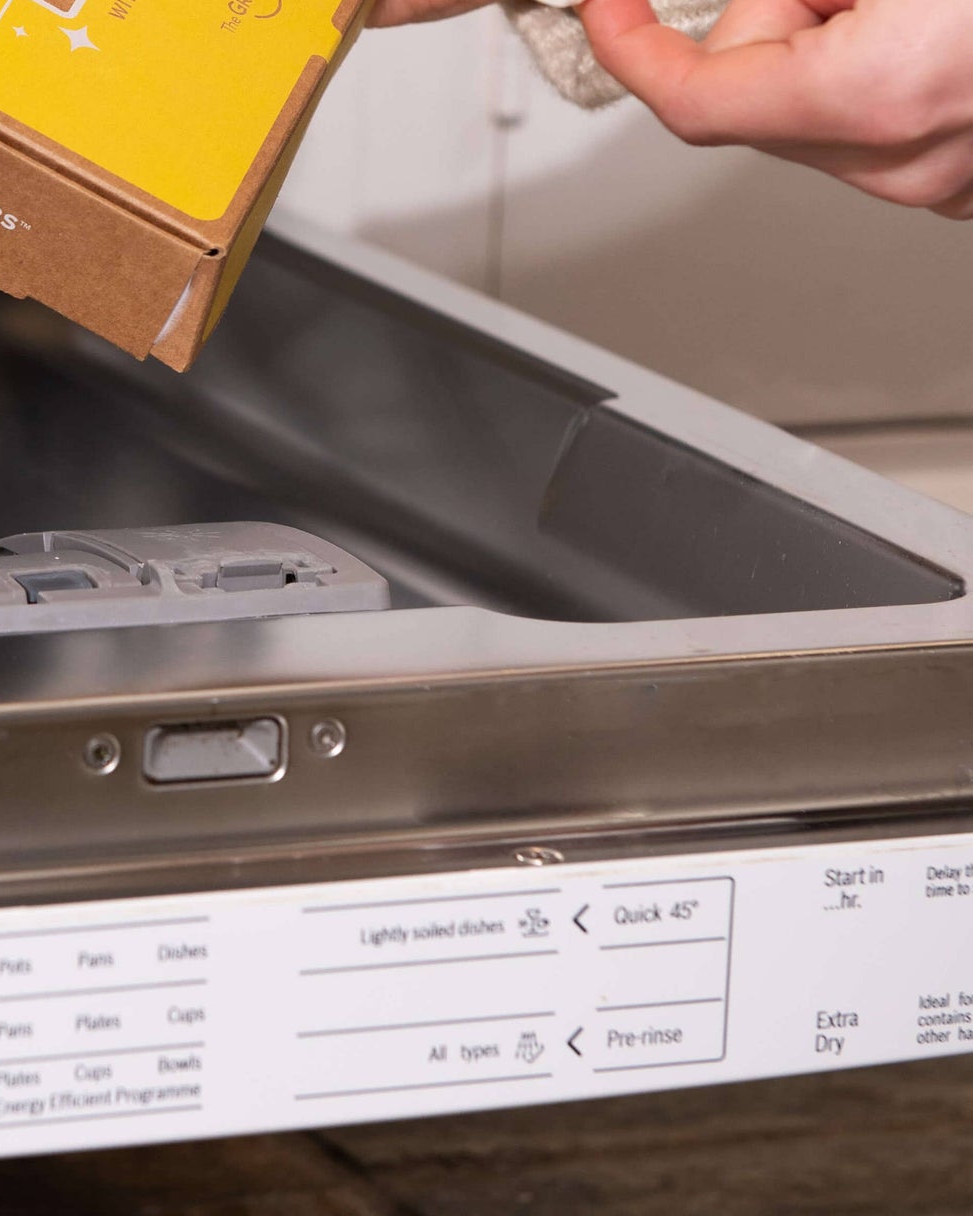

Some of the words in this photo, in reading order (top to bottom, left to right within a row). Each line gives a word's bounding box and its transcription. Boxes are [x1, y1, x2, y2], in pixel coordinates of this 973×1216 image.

[220, 16, 241, 33] The
[824, 867, 866, 887] Start
[868, 865, 884, 884] in
[927, 865, 961, 881] Delay
[926, 884, 954, 897] time
[957, 883, 970, 895] to
[614, 903, 662, 926] Quick
[669, 899, 699, 920] 45°
[361, 925, 408, 945] Lightly
[412, 919, 455, 940] soiled
[458, 916, 504, 936] dishes
[78, 951, 113, 968] Pans
[158, 942, 207, 962] Dishes
[919, 993, 950, 1010] Ideal
[76, 1013, 121, 1032] Plates
[167, 1006, 205, 1025] Cups
[816, 1010, 859, 1030] Extra
[917, 1011, 971, 1027] contains
[607, 1026, 683, 1048] Pre-rinse
[815, 1034, 845, 1055] Dry
[916, 1029, 951, 1044] other
[428, 1045, 447, 1062] All
[461, 1043, 499, 1063] types
[74, 1064, 111, 1083] Cups
